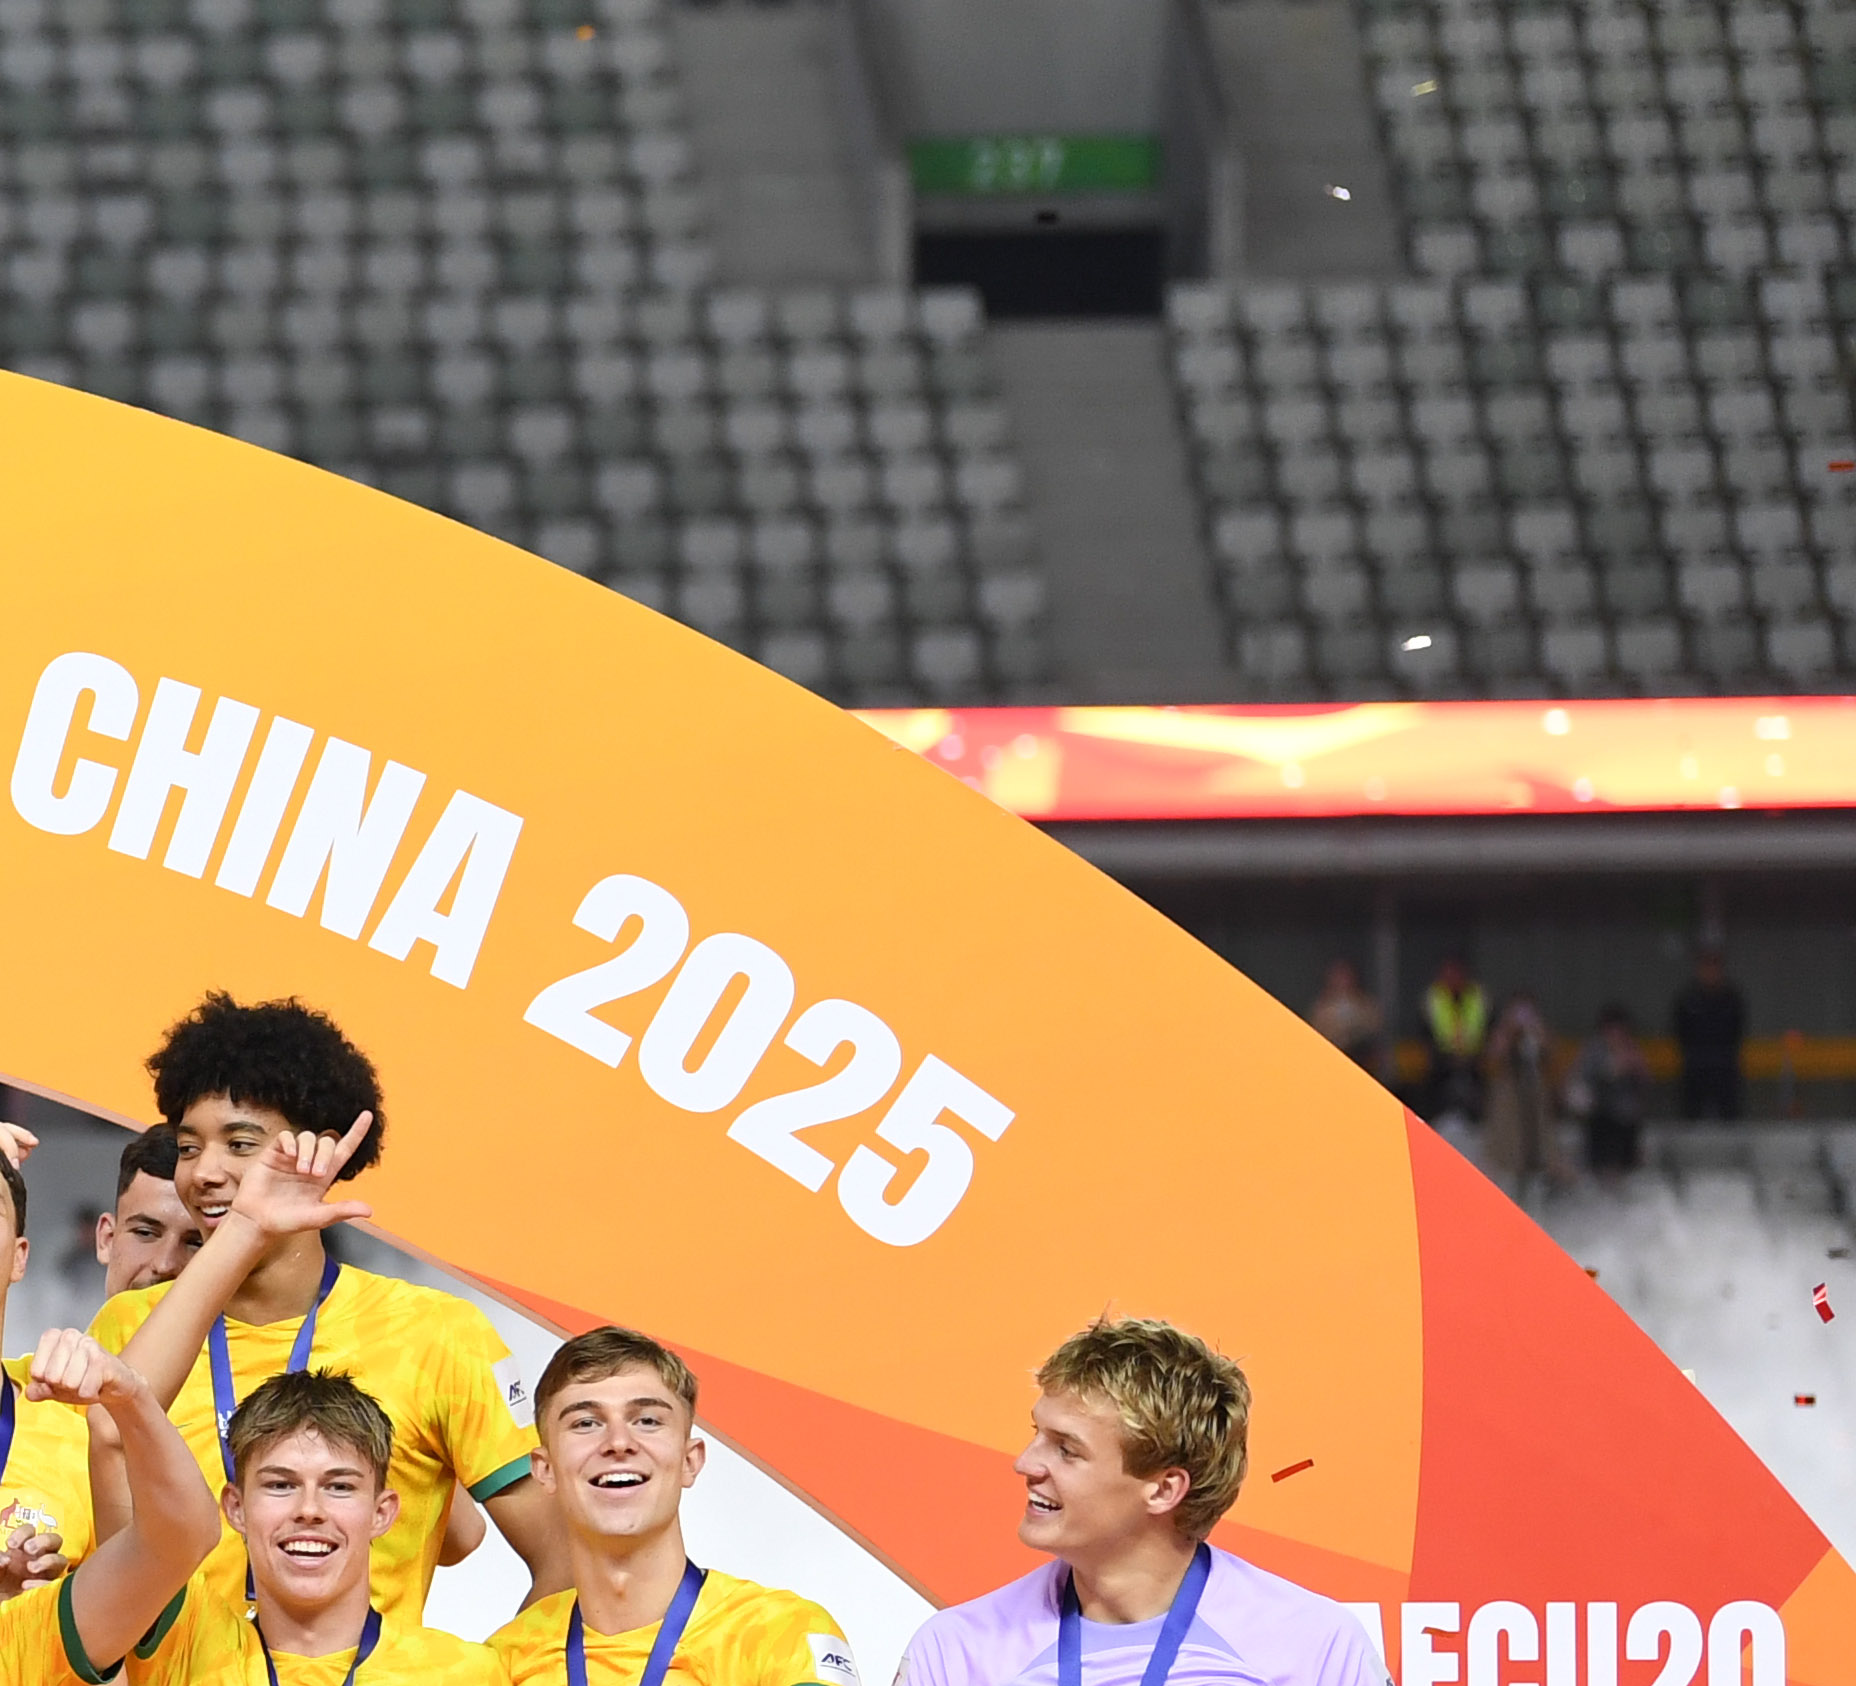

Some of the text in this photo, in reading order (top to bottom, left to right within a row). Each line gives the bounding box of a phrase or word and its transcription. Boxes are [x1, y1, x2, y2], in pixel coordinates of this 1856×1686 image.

[10, 651, 1017, 1248] CHINA 2025
[820, 1652, 853, 1672] AFC
